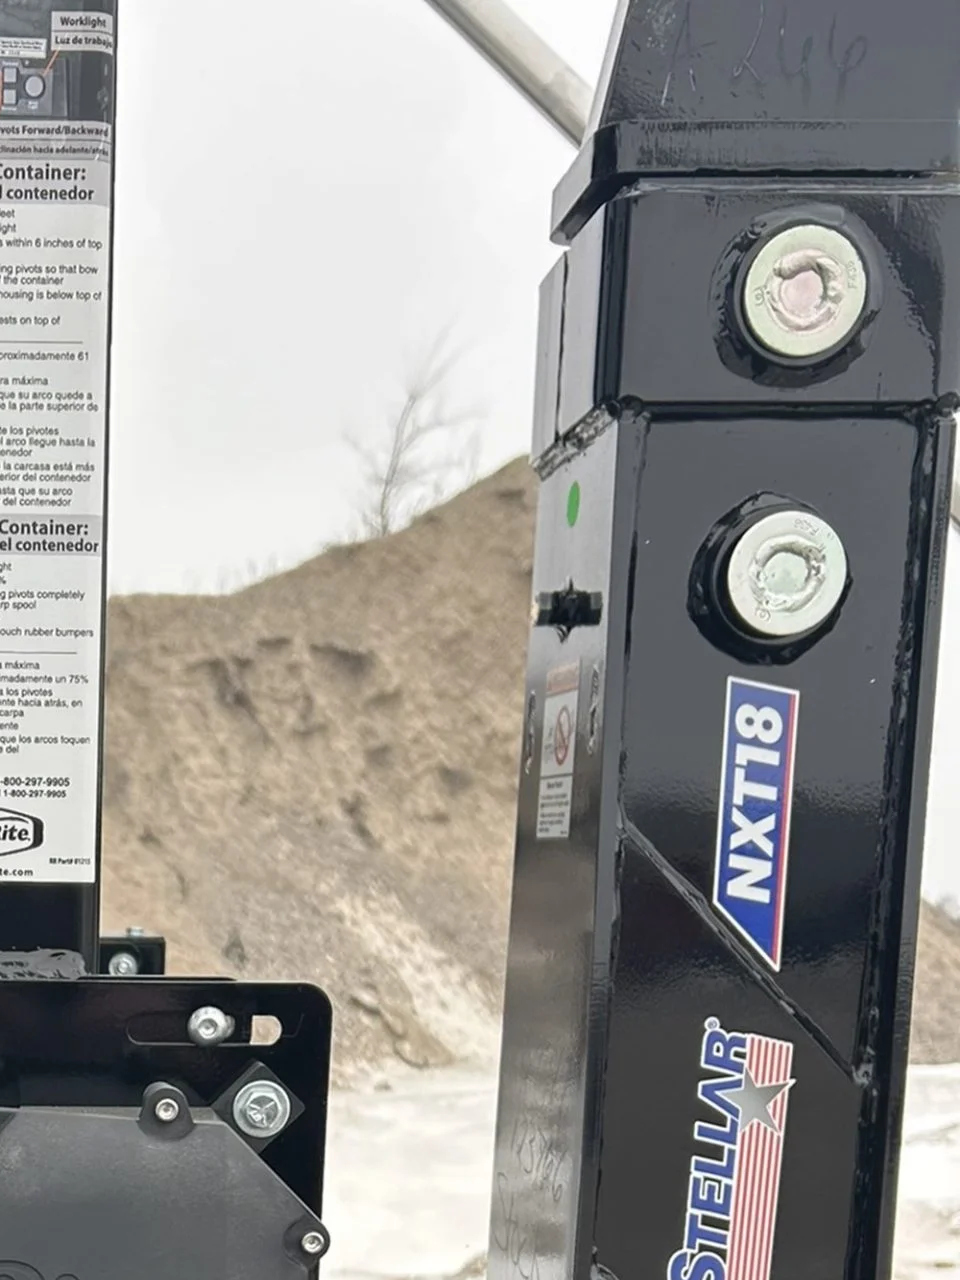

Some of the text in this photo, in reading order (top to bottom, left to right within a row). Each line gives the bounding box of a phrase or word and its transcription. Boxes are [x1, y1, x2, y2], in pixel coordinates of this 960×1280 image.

[60, 16, 106, 28] Worklight
[55, 36, 70, 45] Luz
[72, 36, 83, 46] de
[22, 124, 108, 136] Forward/Backward
[6, 184, 94, 200] contenedor
[5, 238, 32, 247] within
[43, 238, 73, 248] inches
[76, 238, 85, 248] of
[88, 239, 102, 250] top
[0, 536, 11, 550] el
[15, 537, 98, 552] contenedor
[8, 589, 34, 600] pivots
[36, 589, 85, 601] completely
[12, 600, 36, 610] spool
[24, 627, 53, 636] rubber
[55, 627, 93, 638] bumpers
[4, 660, 39, 669] máxima
[3, 789, 66, 798] 1-800-297-9905
[726, 701, 783, 904] NXT18
